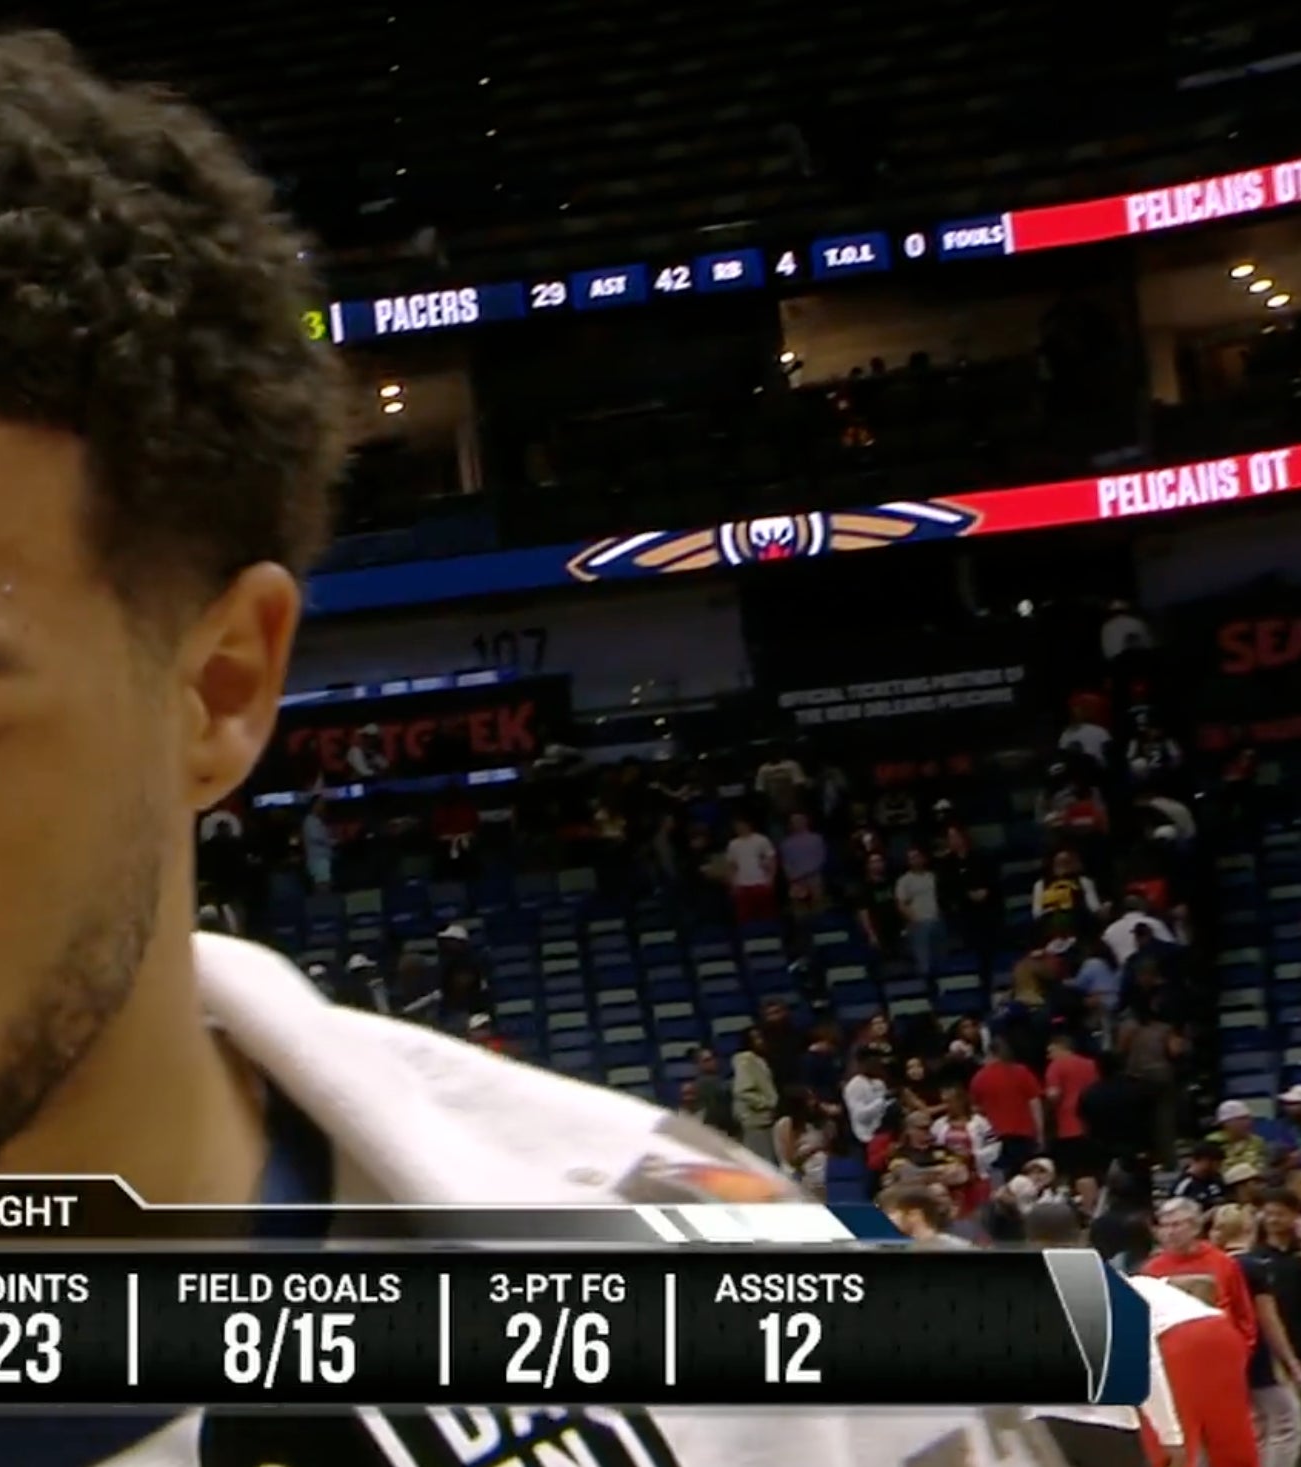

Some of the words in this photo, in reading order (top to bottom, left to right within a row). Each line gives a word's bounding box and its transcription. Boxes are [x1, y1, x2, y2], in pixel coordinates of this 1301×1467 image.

[1126, 168, 1264, 235] PELICANS
[374, 287, 479, 335] PACERS
[531, 281, 568, 309] 29
[589, 274, 628, 298] AST
[654, 265, 693, 292] 42
[775, 251, 798, 276] 4
[904, 232, 926, 258] 0
[942, 223, 1003, 251] FOULS
[1097, 457, 1240, 518] PELICANS
[1248, 449, 1292, 495] OT
